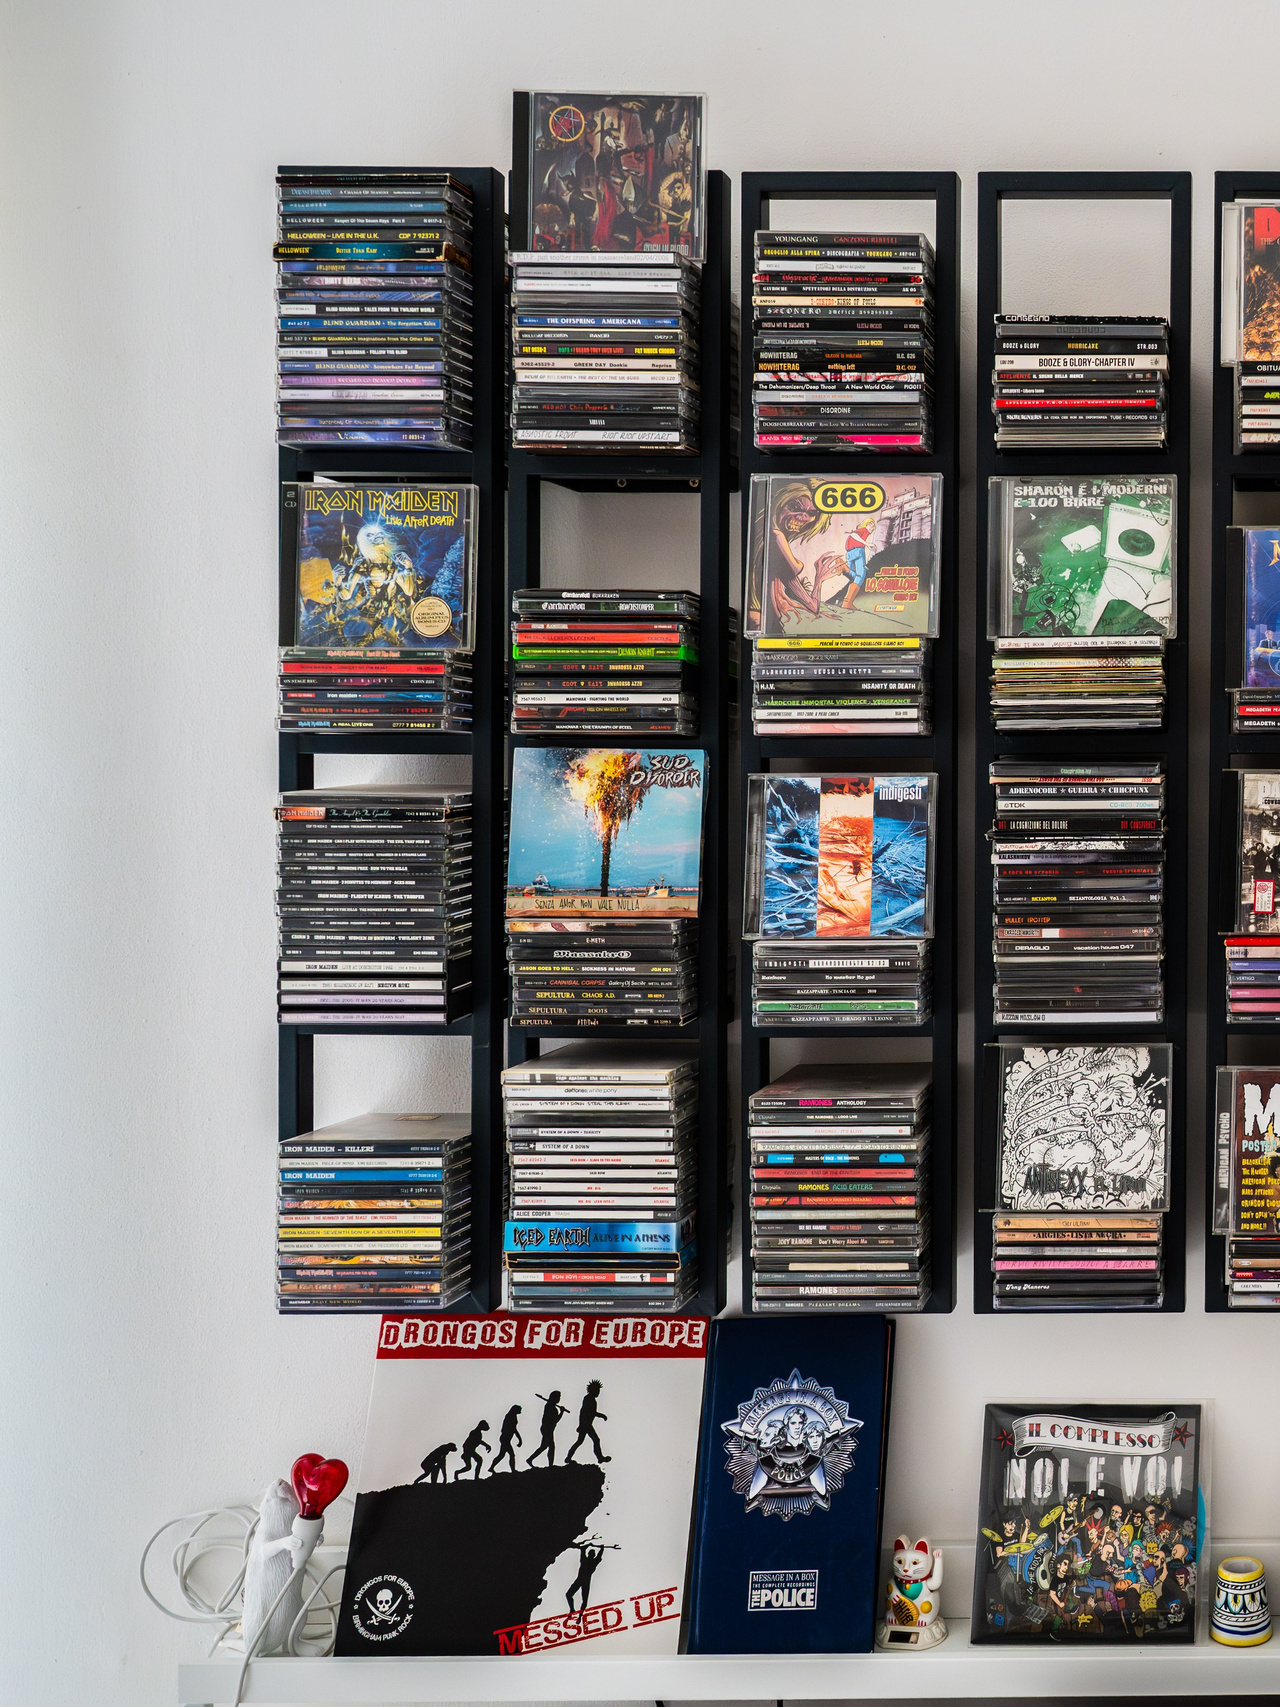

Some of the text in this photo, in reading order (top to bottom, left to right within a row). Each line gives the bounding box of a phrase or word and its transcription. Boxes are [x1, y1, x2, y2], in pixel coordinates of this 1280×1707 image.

[1039, 358, 1135, 367] BOOZE & GLORY-CHAPTER IV
[305, 490, 458, 517] IRON MAIDEN
[821, 488, 876, 507] 666
[879, 785, 922, 802] indigesti
[1242, 1140, 1277, 1152] POSTER
[548, 1227, 590, 1251] EARTH
[381, 1319, 705, 1349] DRONGOS FOR EUROPE
[1028, 1423, 1161, 1448] IL COMPLESSO
[786, 1573, 793, 1581] IN
[794, 1573, 799, 1581] A
[354, 1576, 382, 1601] DRONGOS
[398, 1578, 415, 1601] EUROPE
[752, 1588, 815, 1607] THE POLICE
[499, 1593, 674, 1655] MESSED UP
